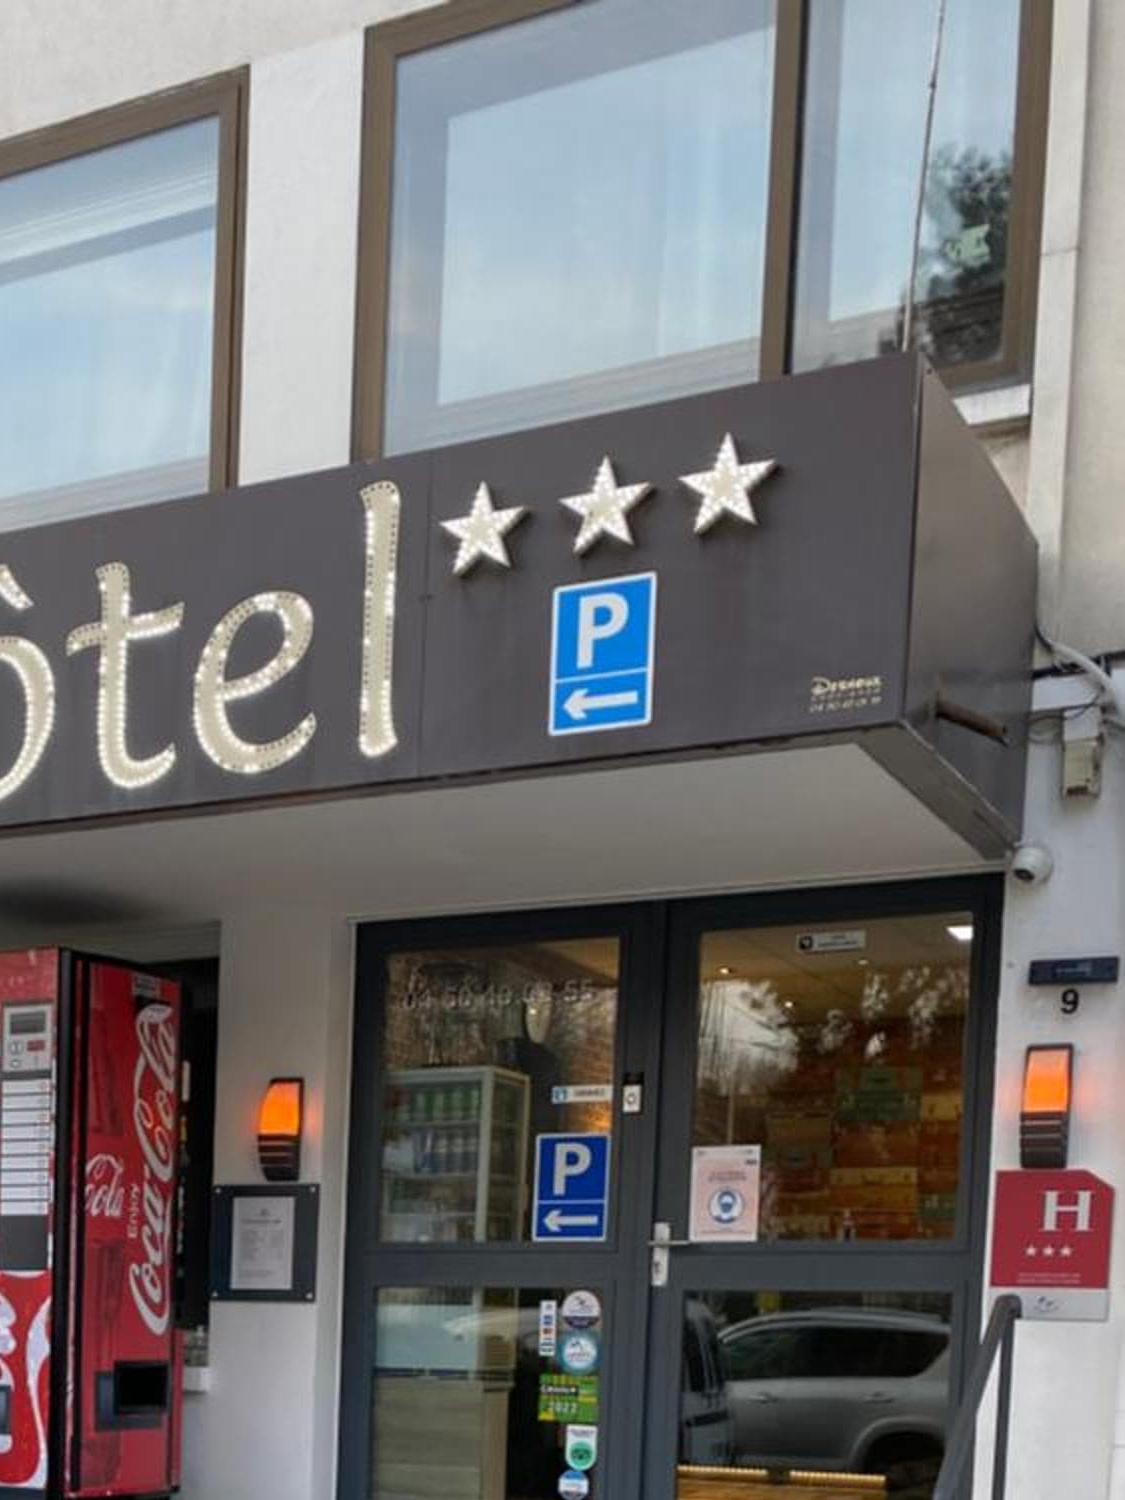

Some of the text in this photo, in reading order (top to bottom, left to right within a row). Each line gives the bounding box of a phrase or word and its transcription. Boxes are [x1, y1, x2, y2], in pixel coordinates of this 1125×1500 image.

[576, 592, 629, 668] P
[1060, 988, 1080, 1014] 9
[553, 1142, 592, 1196] P
[1039, 1189, 1095, 1233] H
